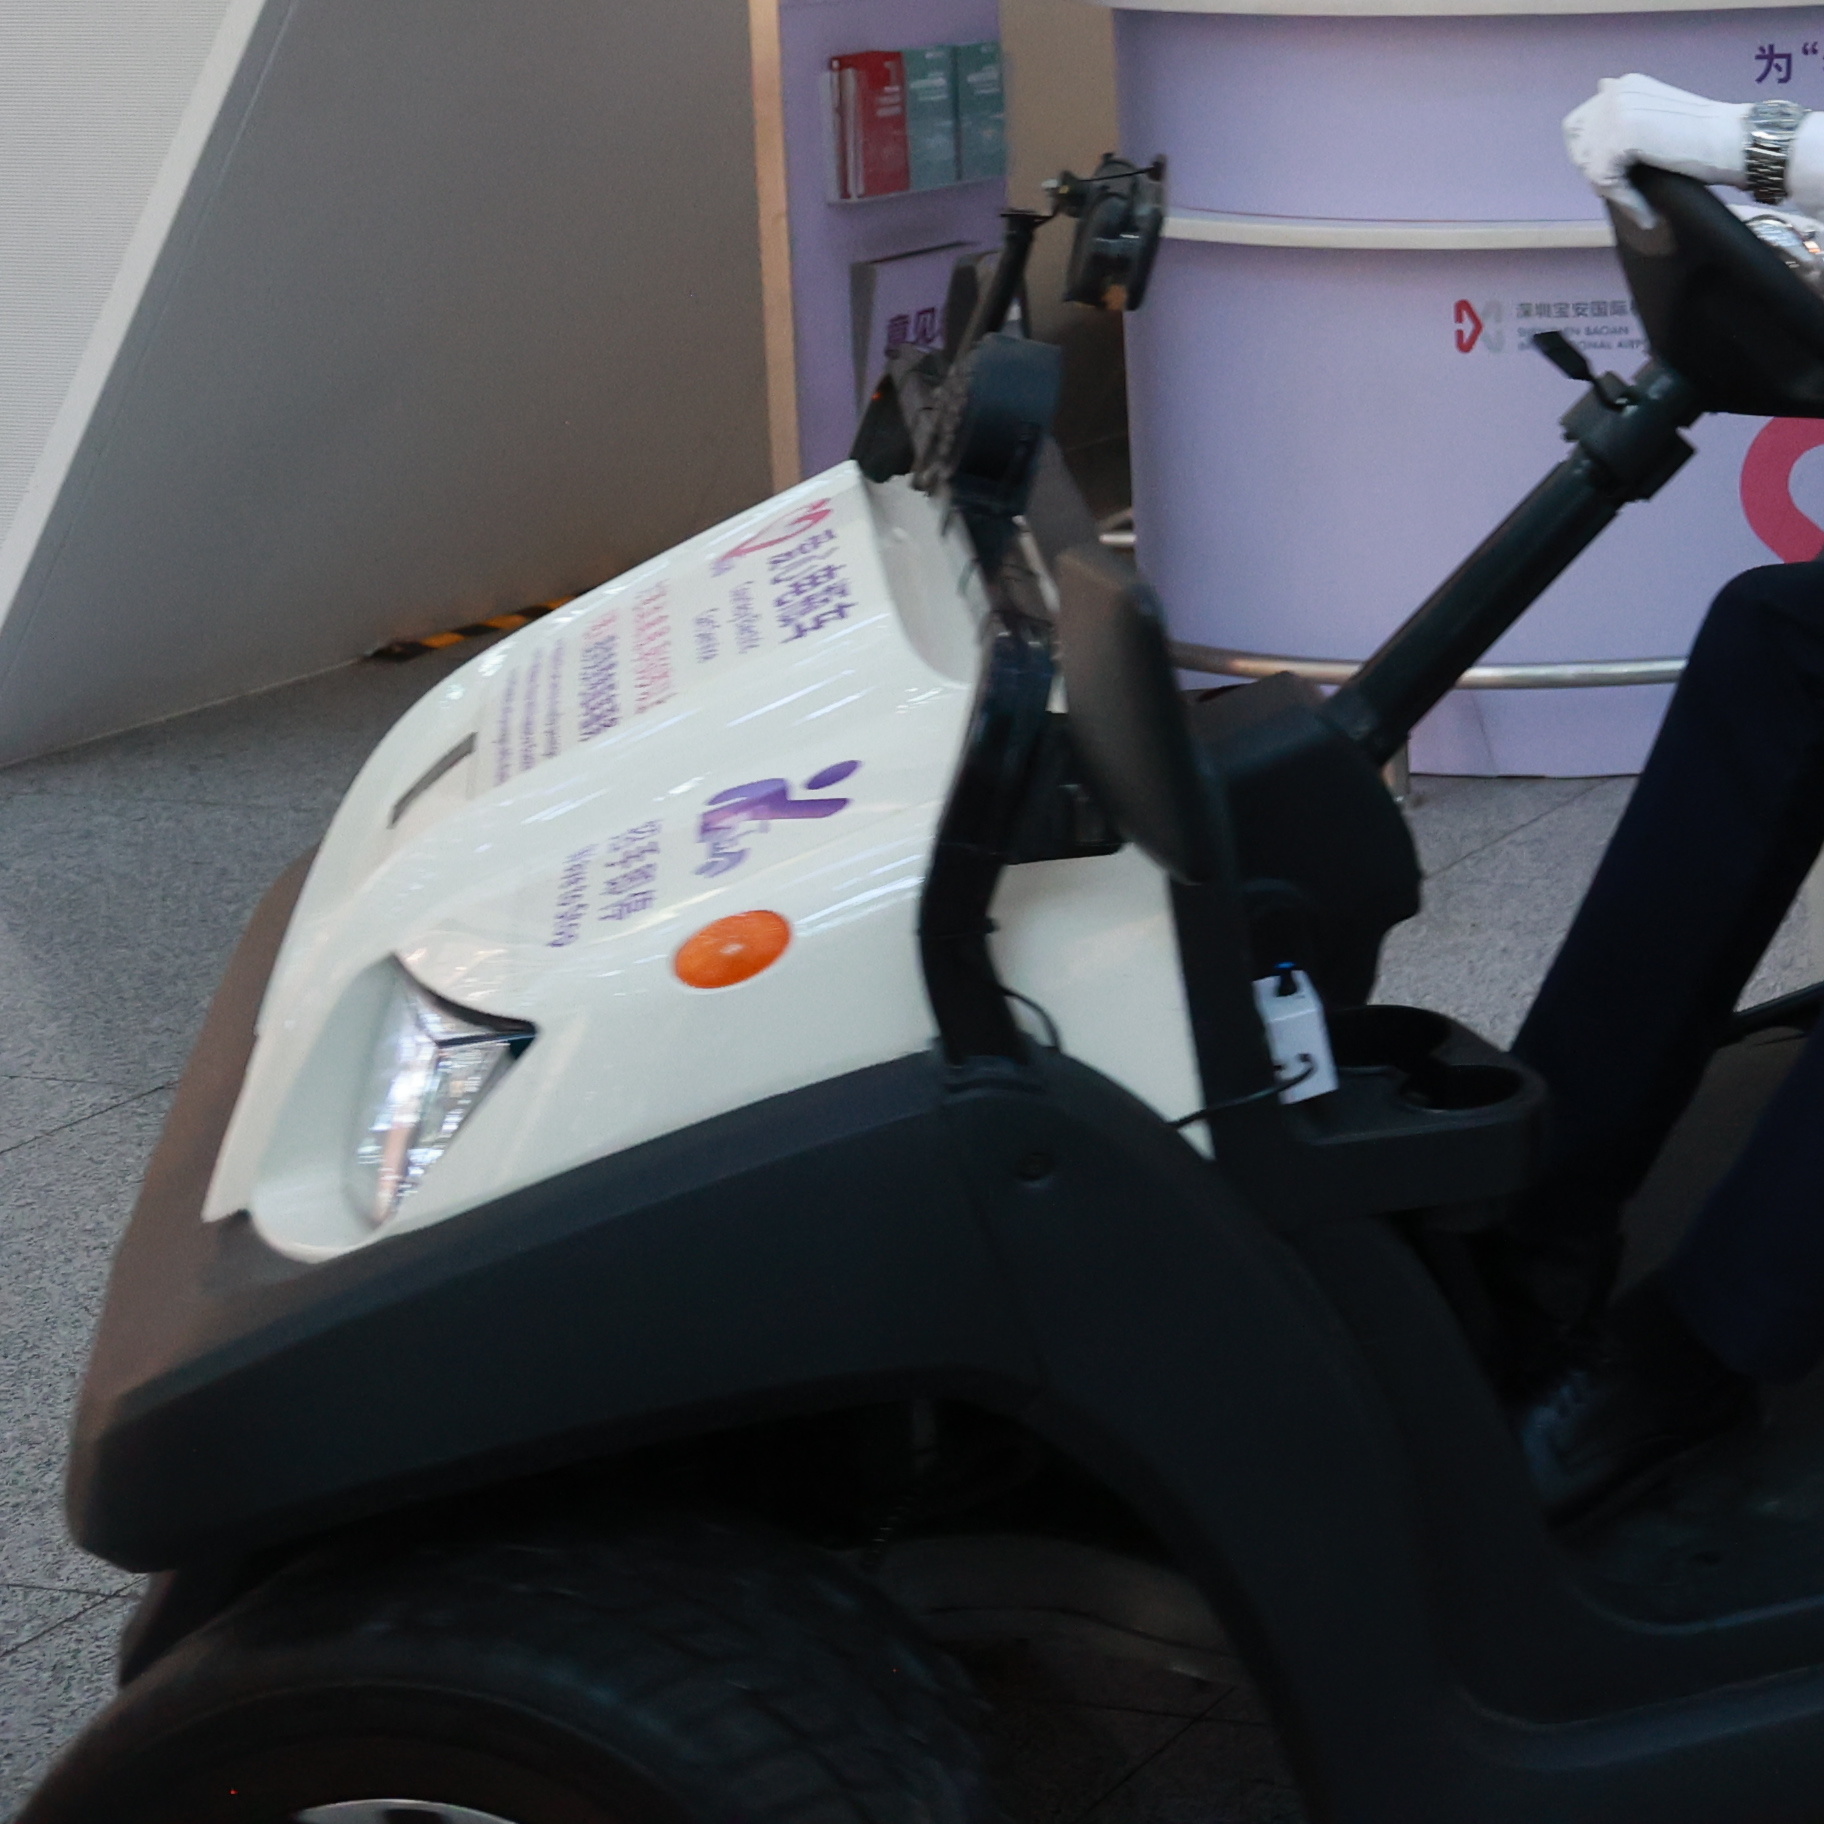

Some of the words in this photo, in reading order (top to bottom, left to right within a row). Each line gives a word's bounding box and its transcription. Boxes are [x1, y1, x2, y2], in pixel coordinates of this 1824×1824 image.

[1516, 300, 1636, 318] 深圳宝安国际
